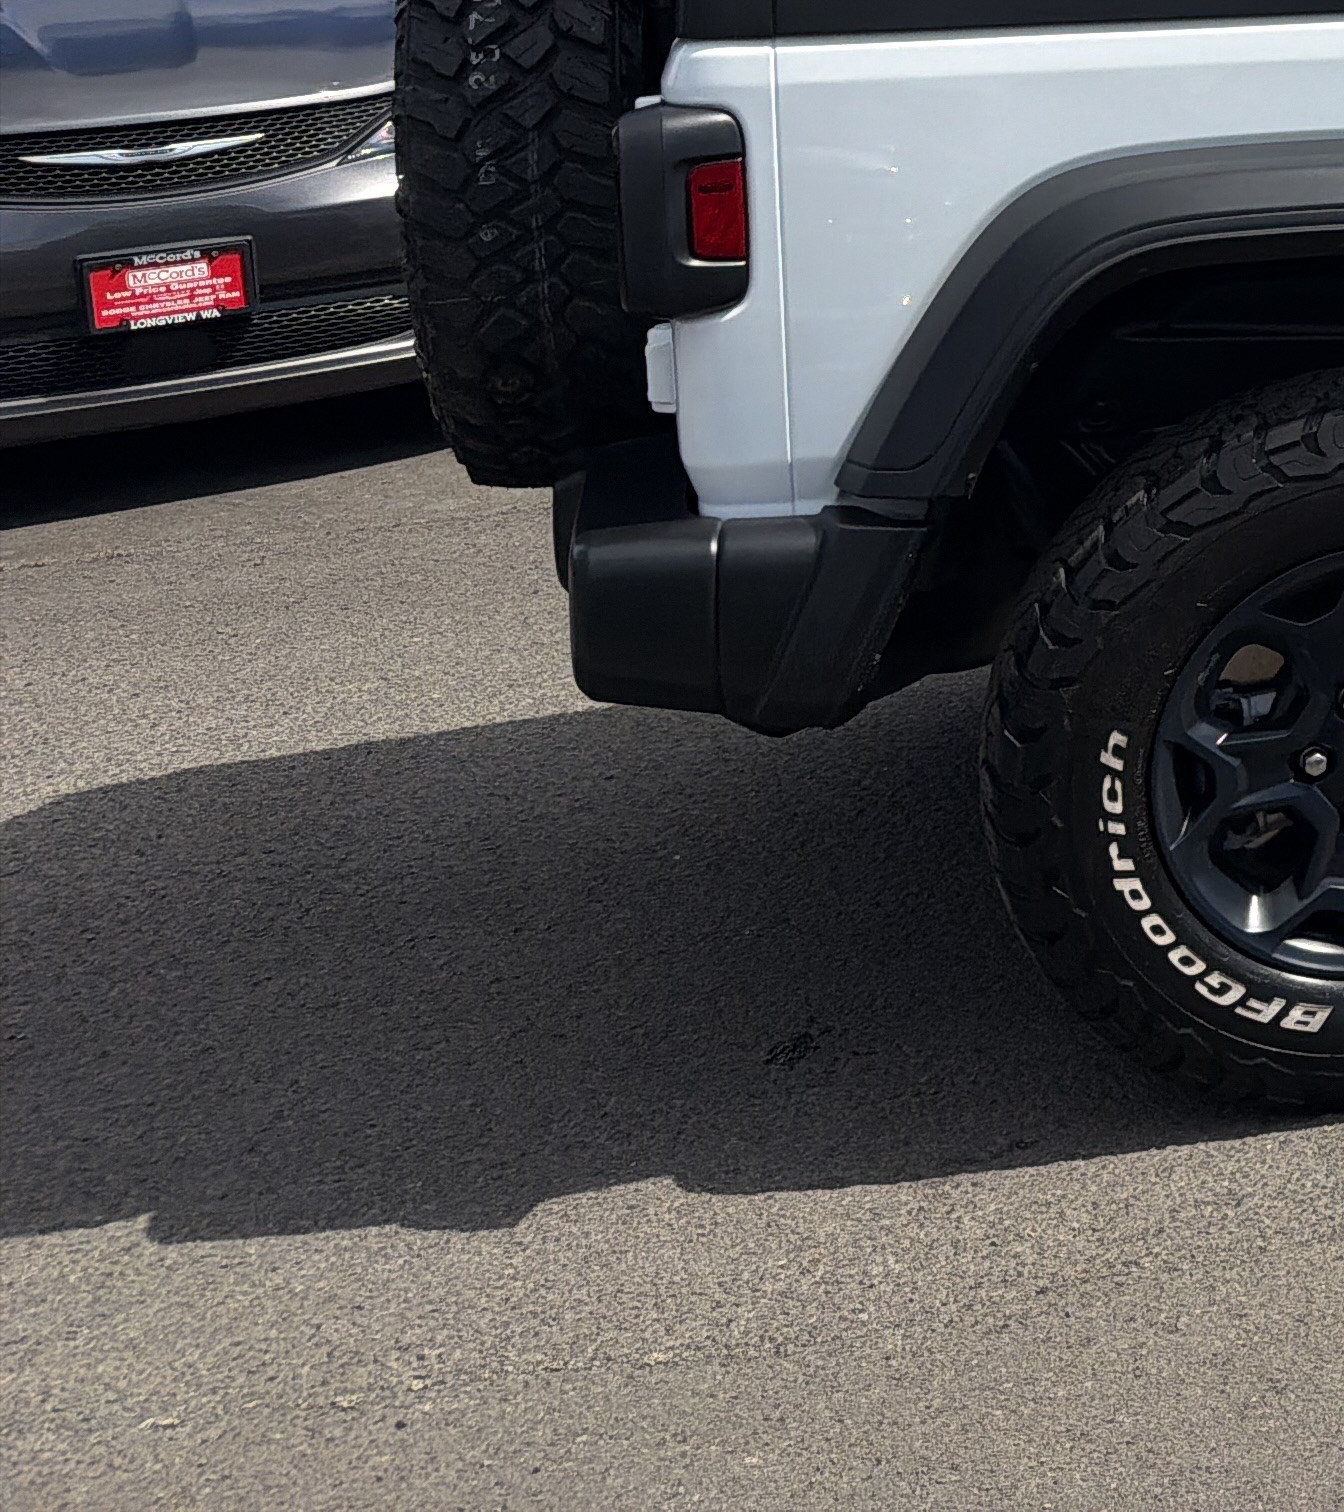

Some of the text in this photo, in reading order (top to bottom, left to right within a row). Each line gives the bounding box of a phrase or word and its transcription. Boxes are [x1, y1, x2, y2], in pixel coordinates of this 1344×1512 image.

[134, 249, 201, 267] McCord's
[131, 265, 206, 286] McCord's
[106, 289, 132, 300] Low
[135, 285, 167, 296] Price
[130, 311, 197, 330] LONGVIEW
[199, 308, 222, 320] WA
[1097, 729, 1335, 1034] BFGoodrich
